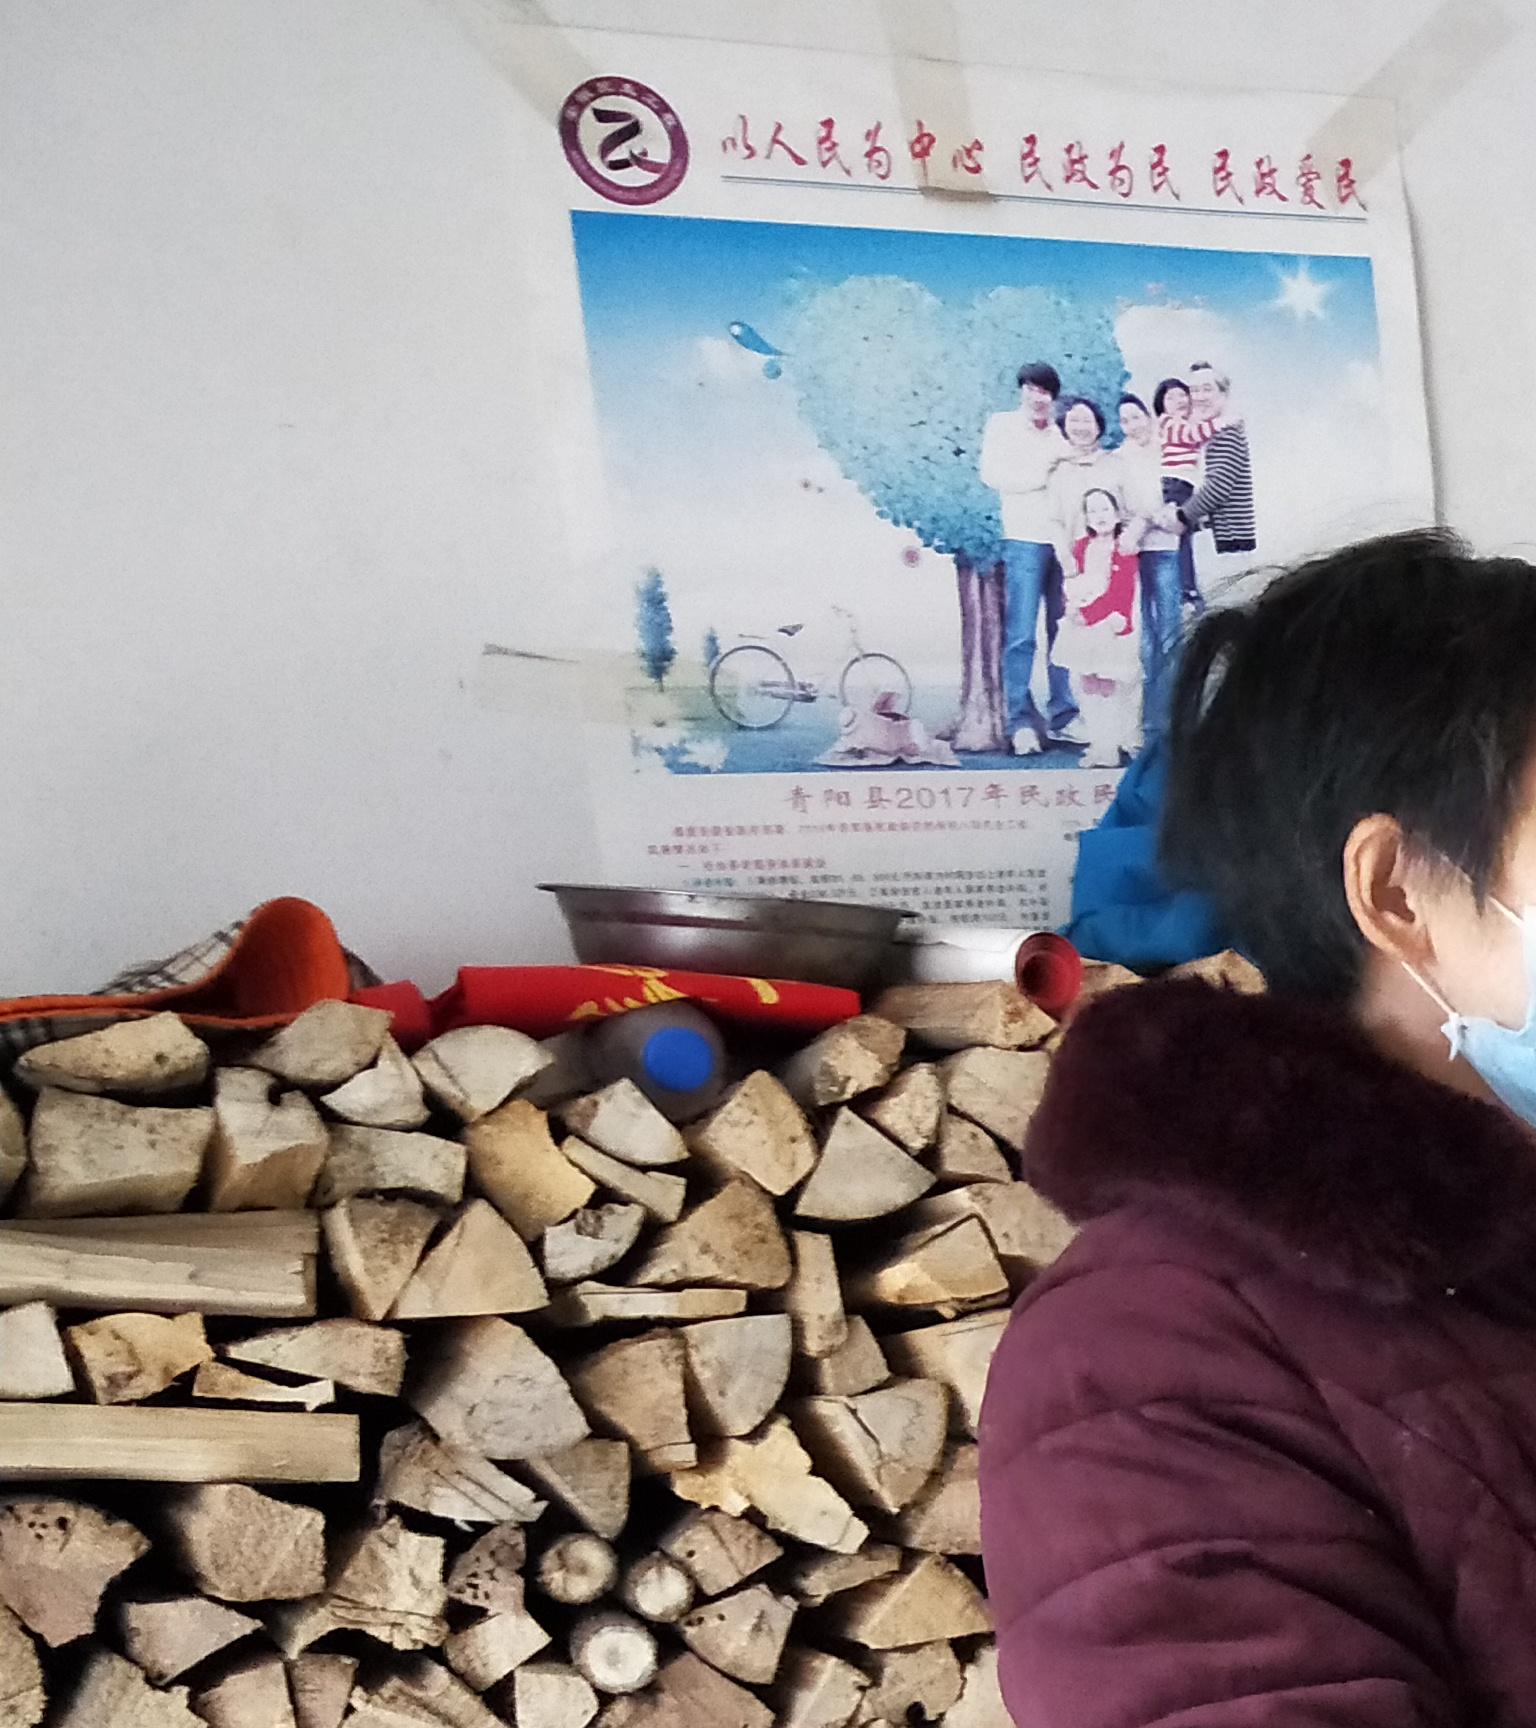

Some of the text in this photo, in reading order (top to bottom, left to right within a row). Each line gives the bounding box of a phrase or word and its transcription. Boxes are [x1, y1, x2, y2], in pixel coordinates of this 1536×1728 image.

[721, 112, 986, 184] 以人民为中心
[1018, 135, 1182, 202] 民政为民
[1210, 149, 1369, 213] 民政爱民
